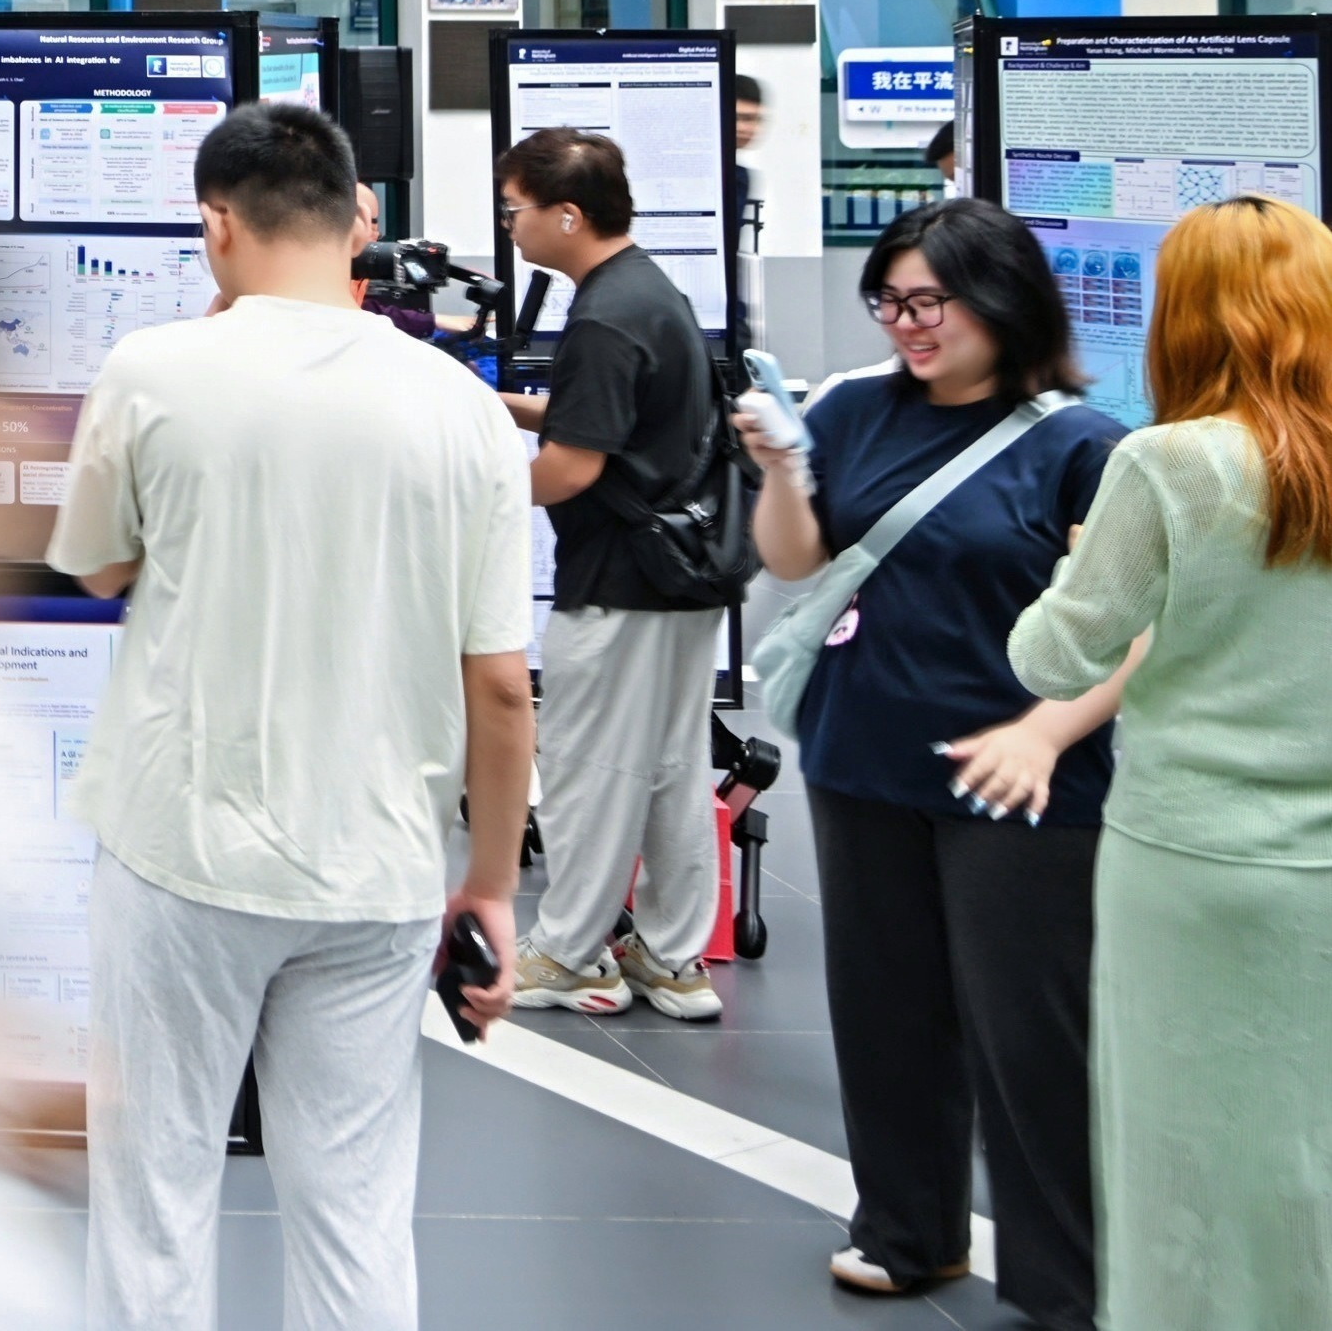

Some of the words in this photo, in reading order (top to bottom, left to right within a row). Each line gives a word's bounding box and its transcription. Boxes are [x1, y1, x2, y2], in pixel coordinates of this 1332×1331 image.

[68, 36, 104, 44] Resources
[121, 36, 166, 44] Environment
[201, 37, 223, 45] Group
[1057, 38, 1093, 46] Preparation
[1109, 37, 1173, 45] Characterization
[1175, 36, 1184, 44] of
[1258, 36, 1290, 44] Capsule
[1, 56, 41, 64] imbalances
[45, 56, 52, 64] in
[56, 56, 63, 64] AI
[67, 56, 106, 65] integration
[110, 56, 120, 64] for
[94, 89, 151, 97] METHODOLOGY
[2, 422, 28, 432] 50%
[11, 647, 65, 657] Indications
[69, 649, 88, 657] and
